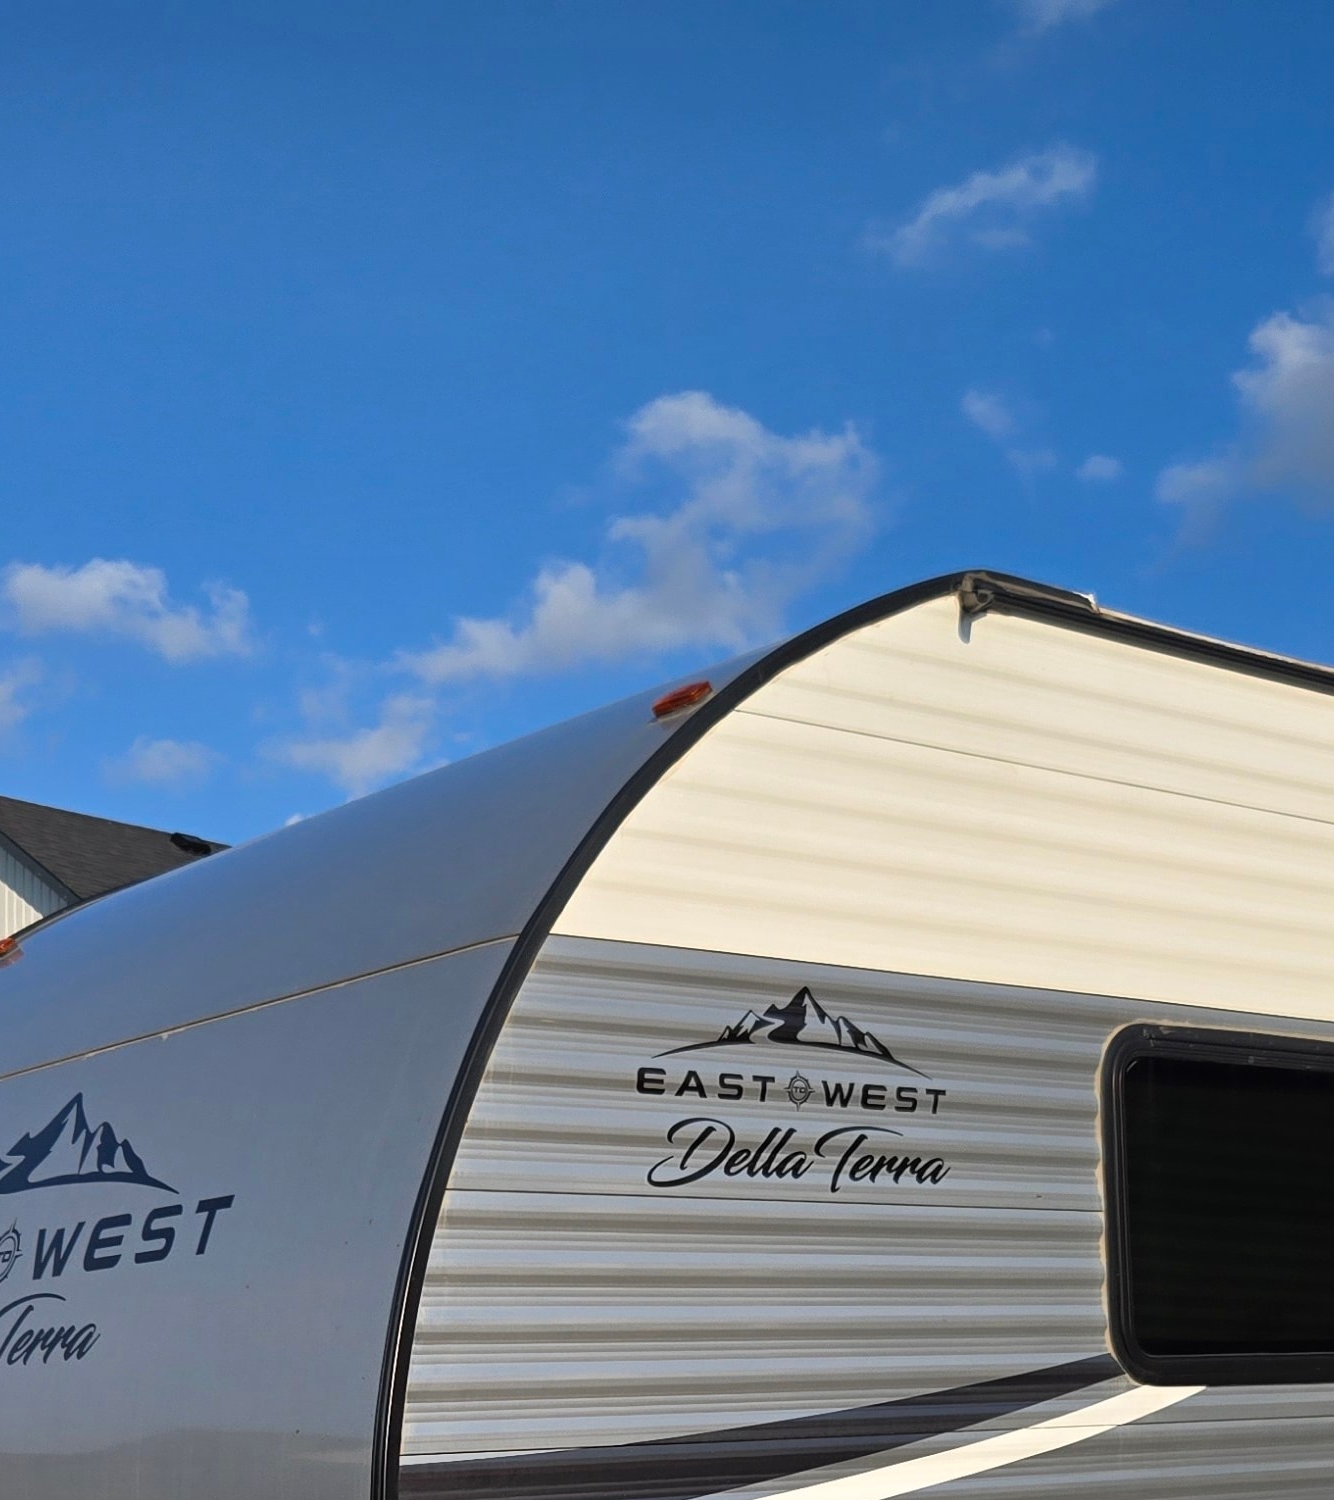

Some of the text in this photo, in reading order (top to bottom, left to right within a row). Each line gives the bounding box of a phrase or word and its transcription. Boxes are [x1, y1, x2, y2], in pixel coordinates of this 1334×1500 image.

[636, 1067, 947, 1115] EAST TO WEST
[647, 1117, 952, 1193] Della Terra
[32, 1194, 236, 1281] WEST
